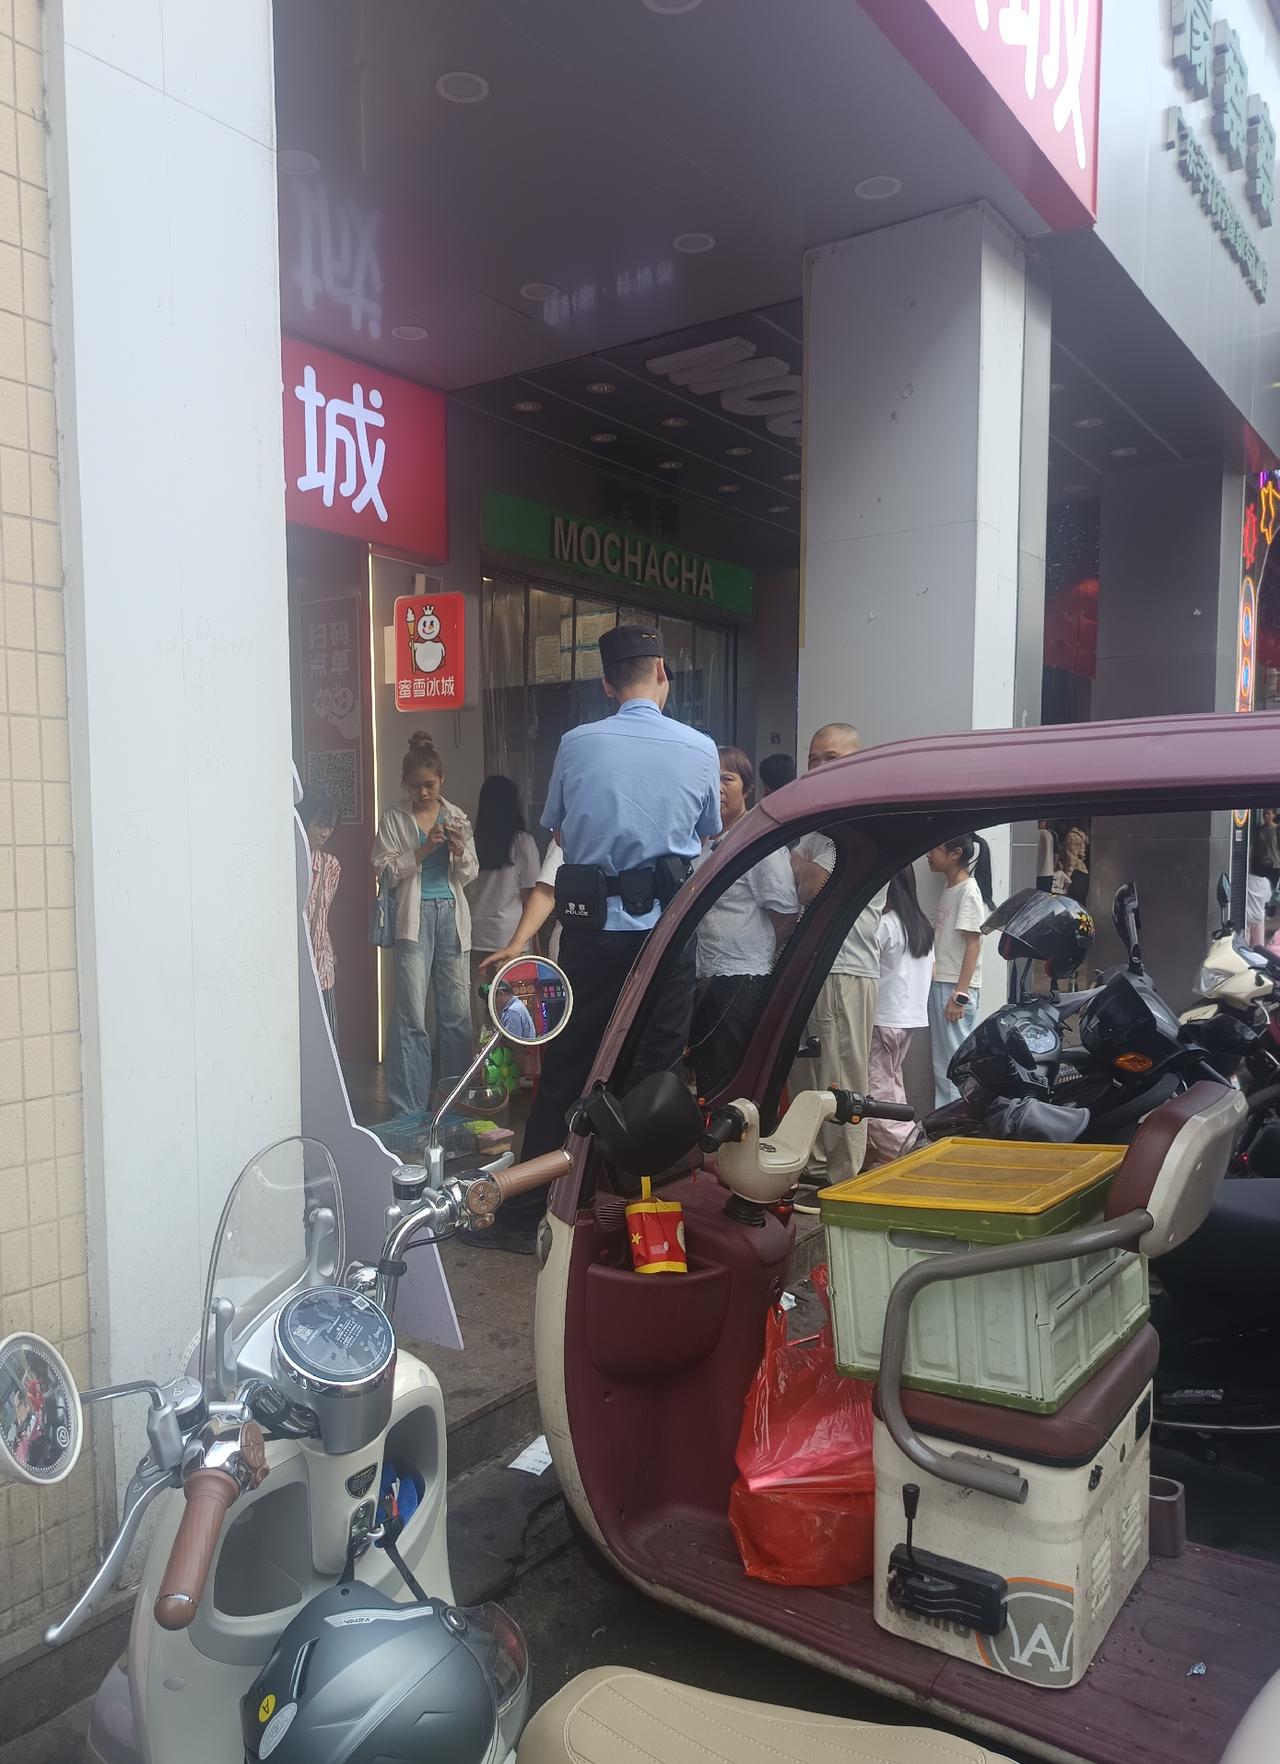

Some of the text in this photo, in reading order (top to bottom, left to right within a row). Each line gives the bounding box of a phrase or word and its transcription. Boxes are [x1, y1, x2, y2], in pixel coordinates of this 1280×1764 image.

[295, 365, 388, 522] 城
[554, 515, 714, 599] MOCHACHA
[308, 619, 350, 650] 扫码
[309, 649, 352, 678] 点单
[399, 675, 455, 699] 蜜雪冰城
